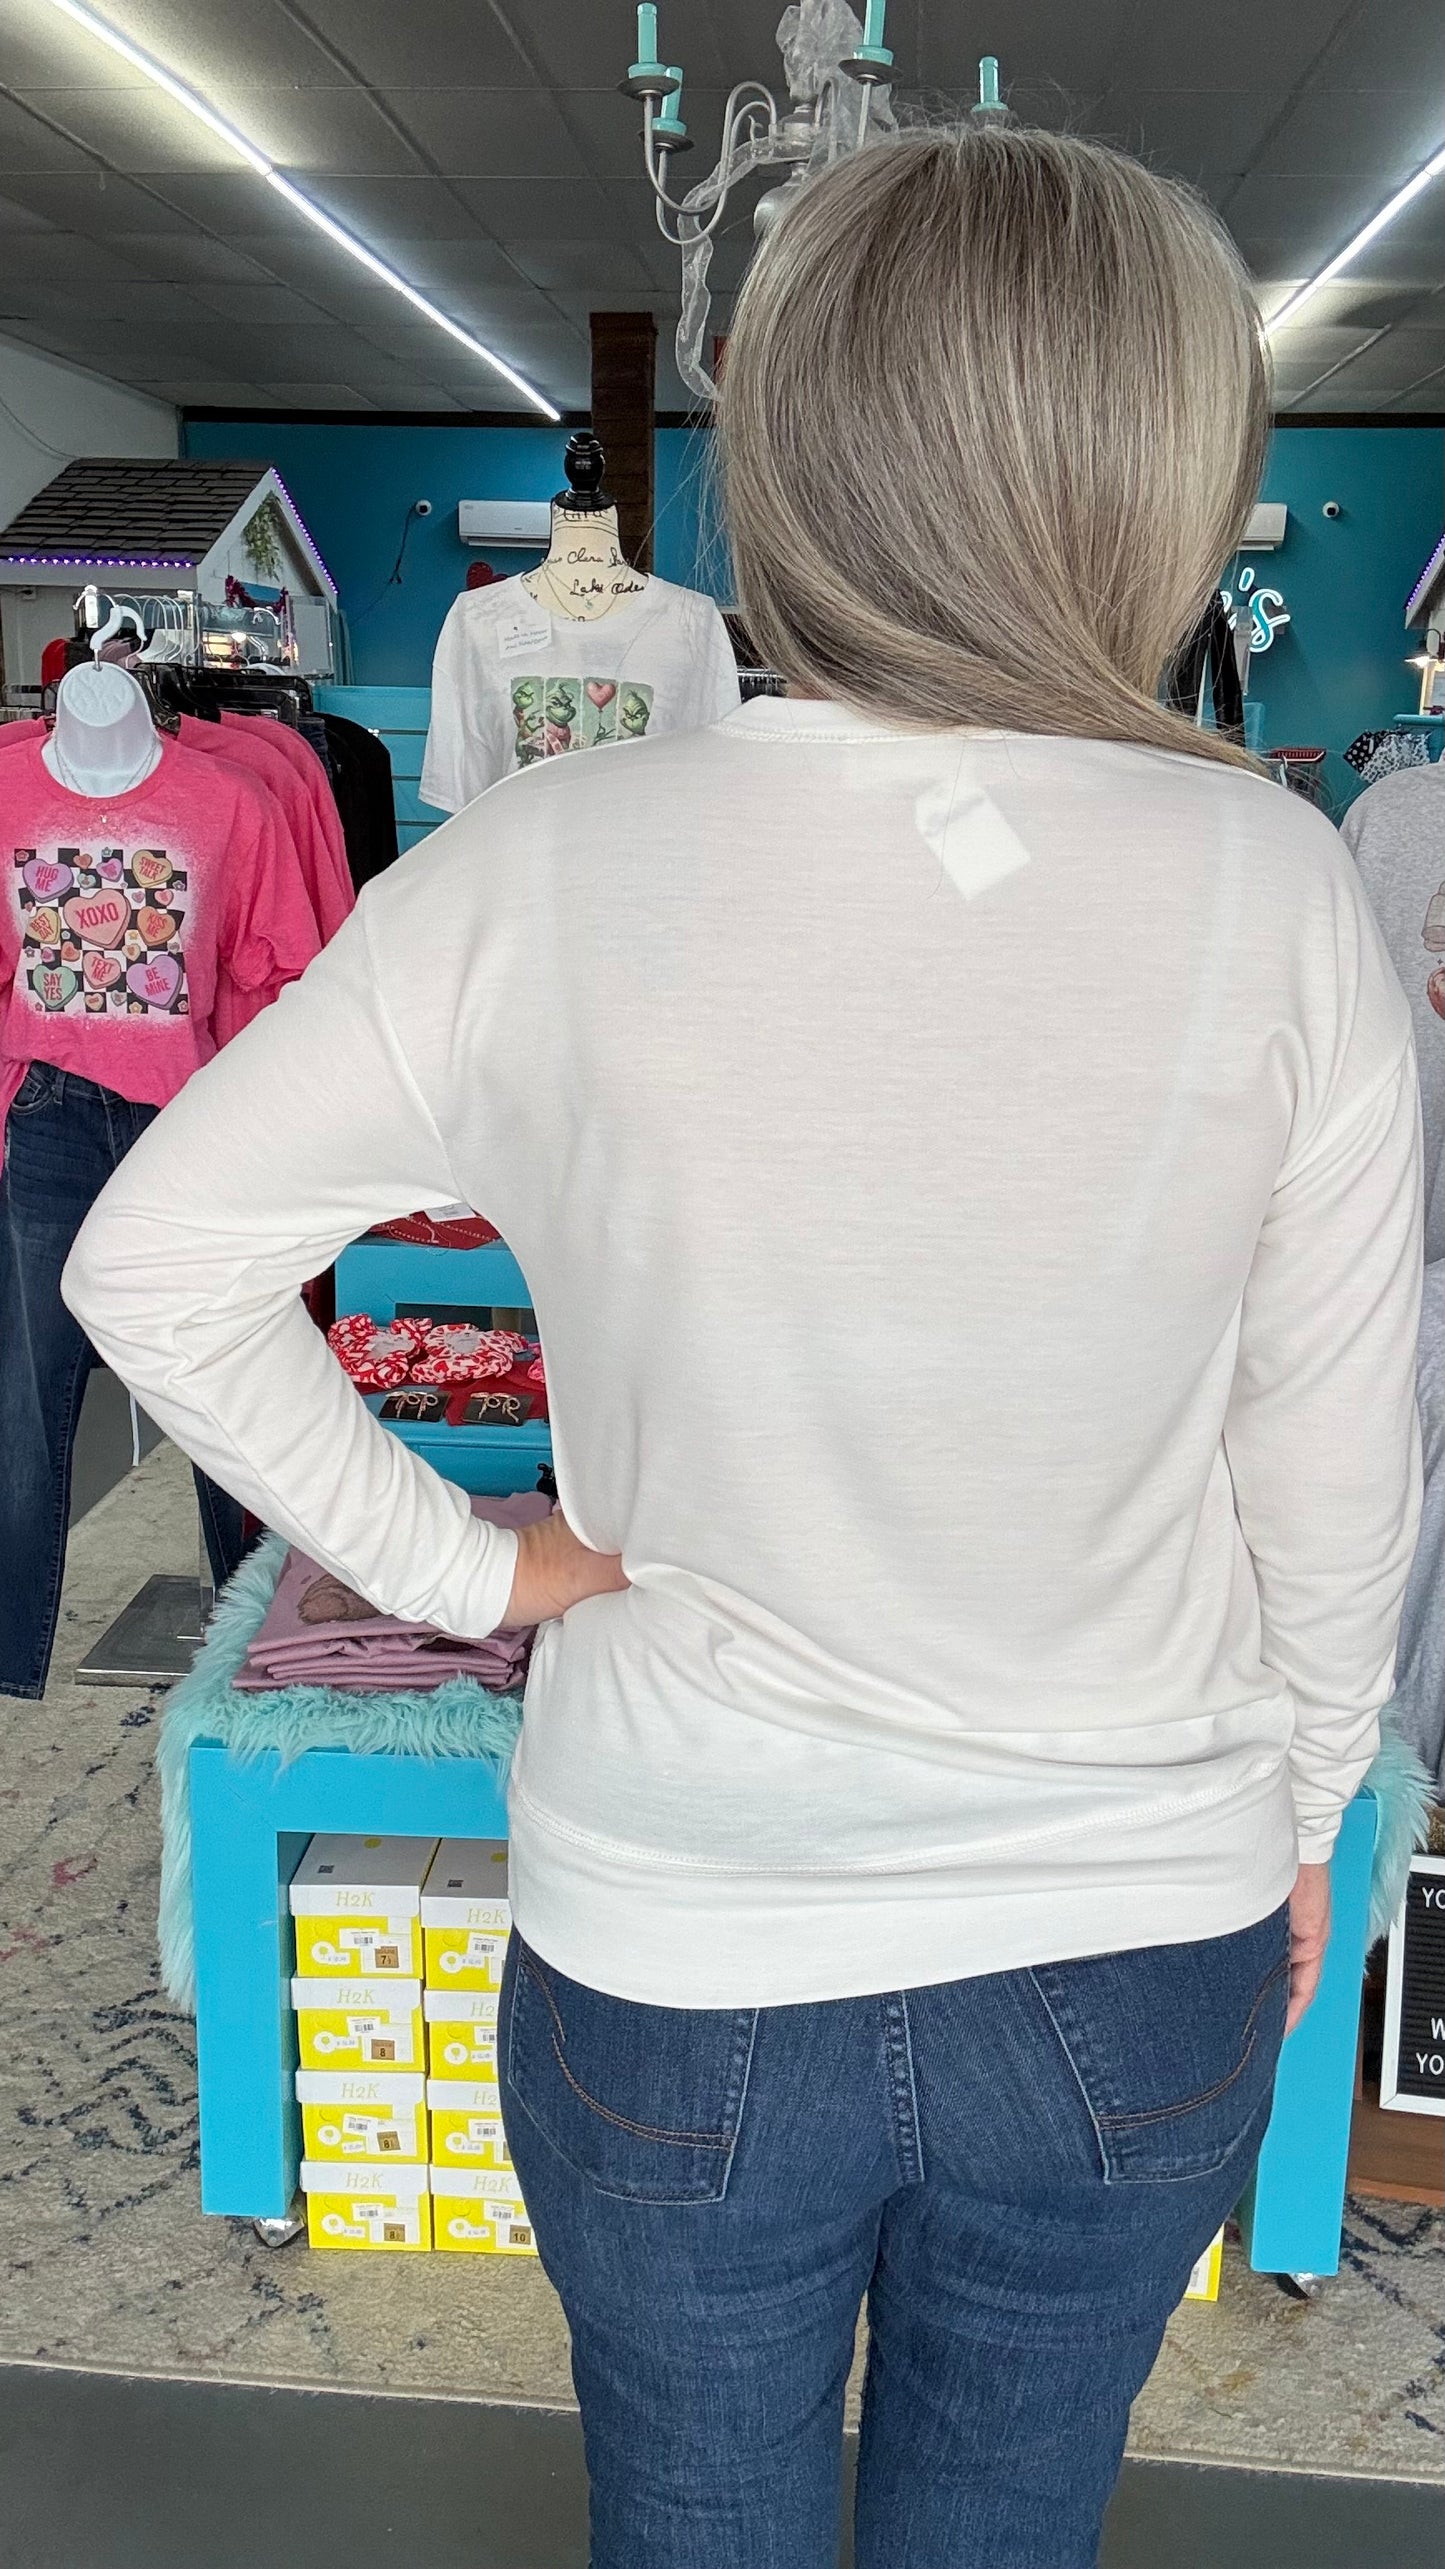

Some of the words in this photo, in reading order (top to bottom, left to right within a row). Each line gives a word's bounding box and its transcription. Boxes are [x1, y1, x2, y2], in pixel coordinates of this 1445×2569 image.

[36, 866, 59, 881] HUG
[139, 857, 167, 874] SWEET
[35, 878, 53, 892] ME
[73, 902, 119, 930] XOXO
[148, 913, 168, 930] KISS
[146, 923, 160, 938] ME
[92, 956, 115, 975] TEXT
[43, 973, 63, 987] SAY
[91, 967, 105, 982] ME
[145, 966, 161, 982] BE
[43, 987, 63, 1000] YES
[144, 977, 171, 996] MINE
[335, 1891, 376, 1907] H2K
[466, 1907, 507, 1924] H2K
[336, 1989, 375, 2004] H2K
[341, 2083, 380, 2099] H2K
[346, 2172, 385, 2189] H2K
[473, 2176, 513, 2193] H2K
[513, 2232, 526, 2242] 10
